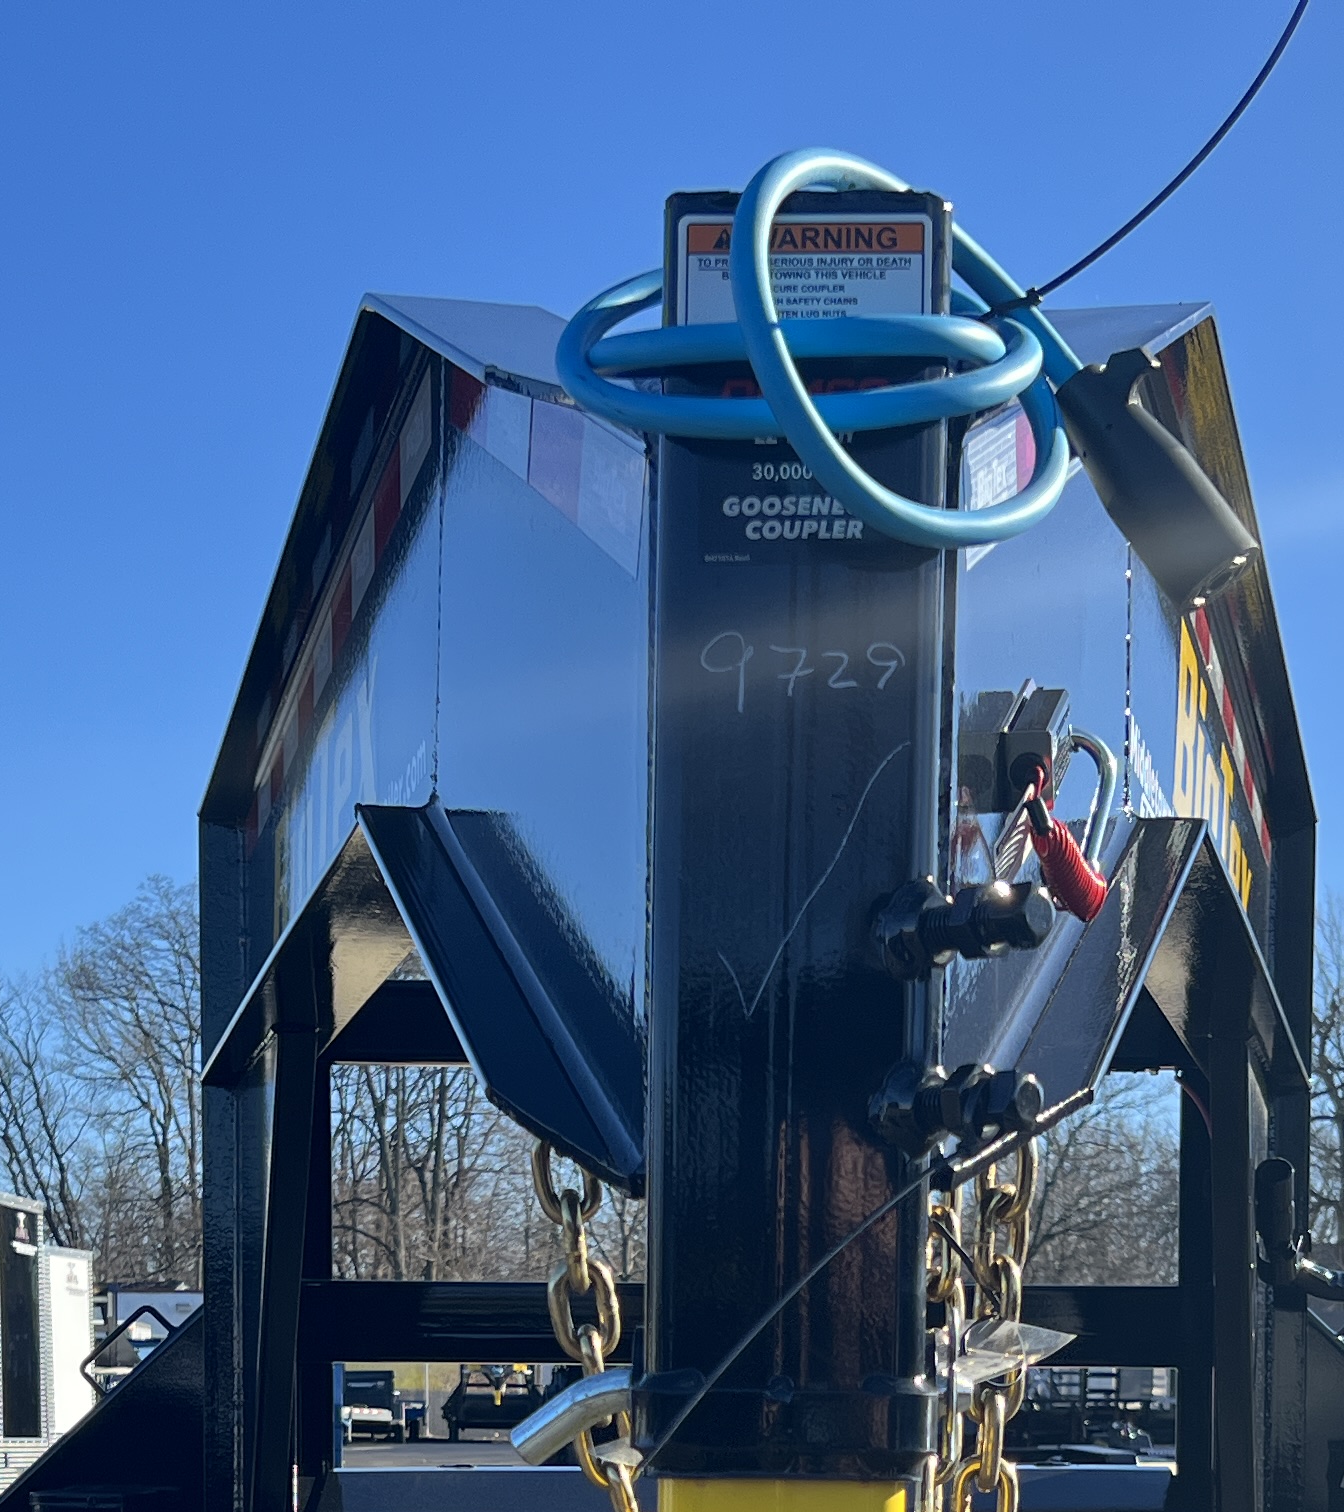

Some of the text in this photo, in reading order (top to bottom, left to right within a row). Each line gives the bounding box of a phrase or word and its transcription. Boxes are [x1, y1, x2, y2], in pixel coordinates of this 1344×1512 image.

[770, 226, 898, 249] ARNING
[698, 257, 711, 268] TO
[771, 257, 814, 268] ERIOUS
[816, 257, 855, 268] INJURY
[857, 257, 873, 268] OR
[876, 257, 912, 267] DEATH
[815, 270, 838, 280] THIS
[841, 270, 886, 280] VEHICLE
[773, 284, 845, 294] CURE COUPLER
[786, 297, 821, 306] SAFETY
[823, 297, 858, 306] CHAINS
[752, 462, 813, 482] 30,000
[722, 495, 853, 517] GOOSENE
[745, 519, 864, 540] COUPLER
[700, 631, 906, 714] 9729
